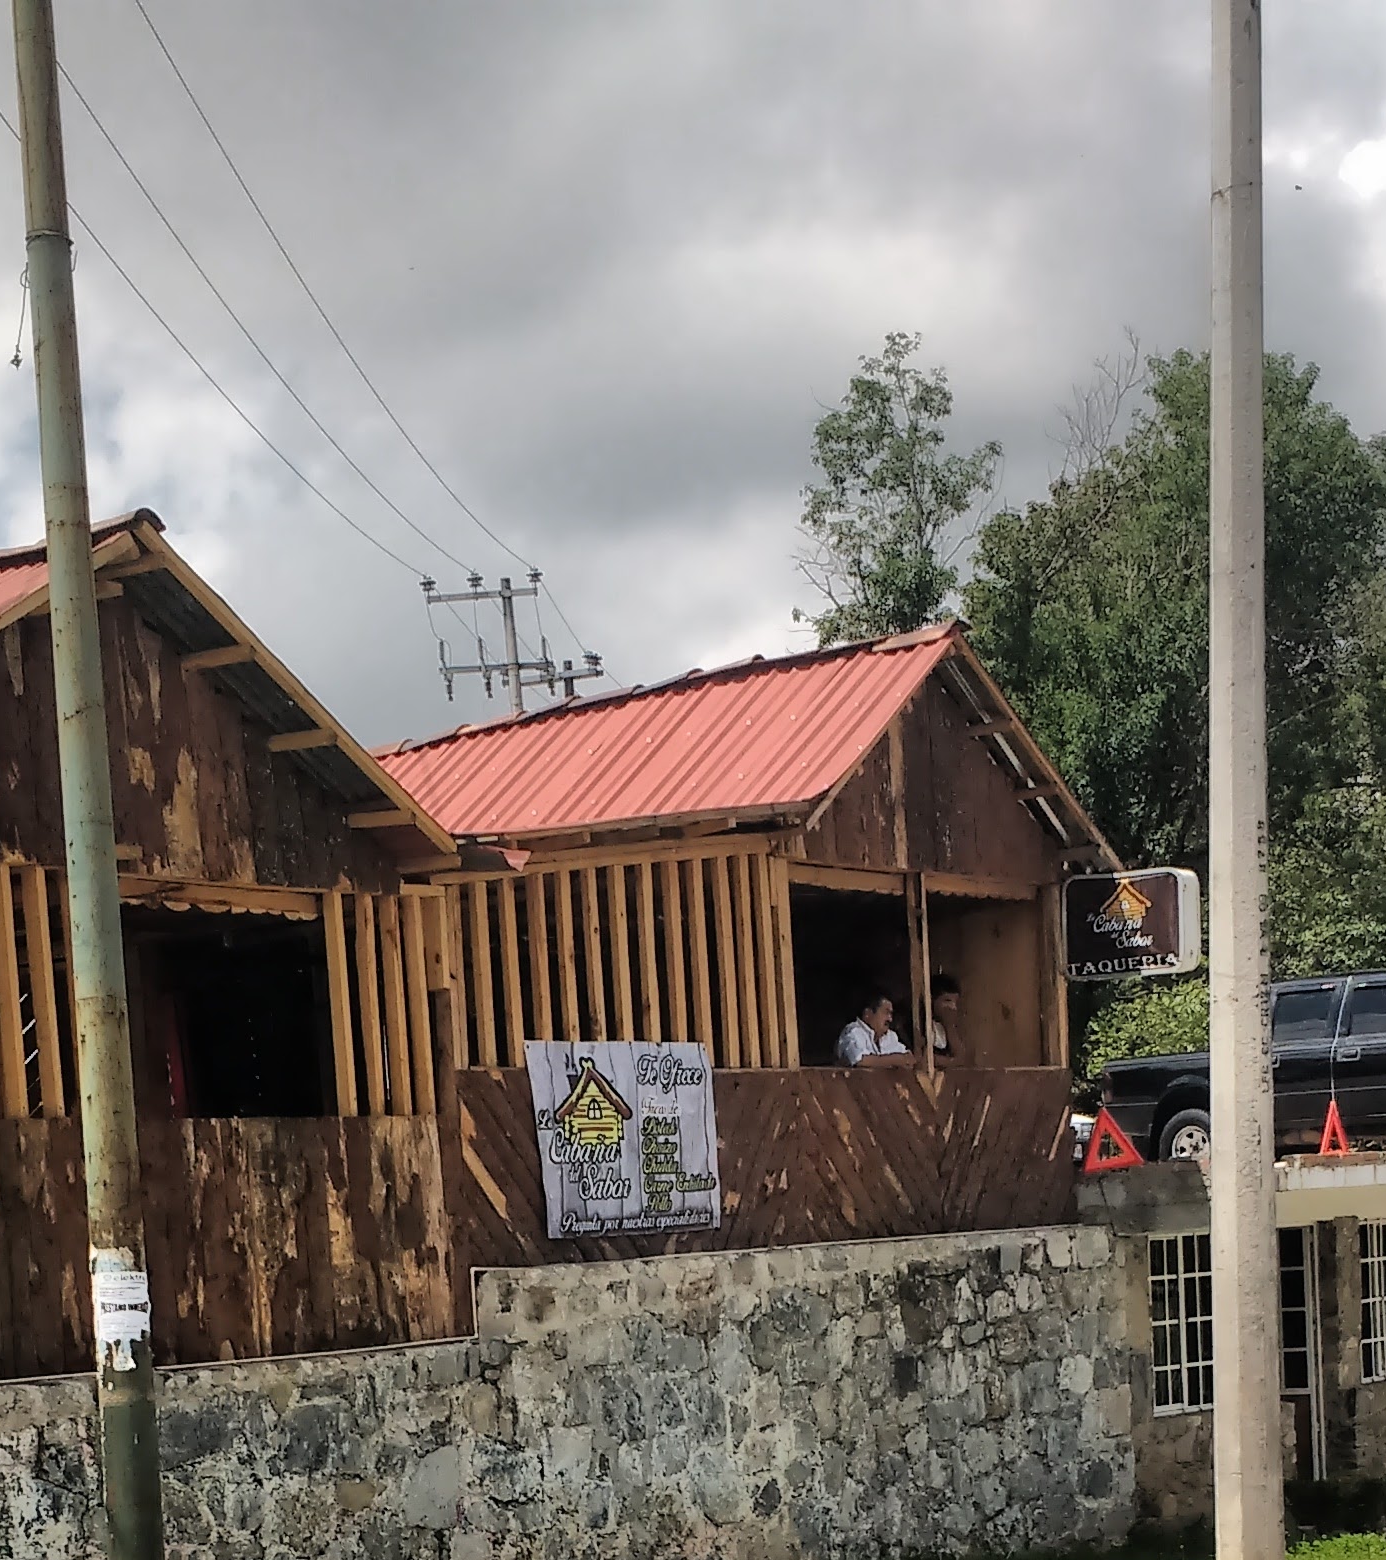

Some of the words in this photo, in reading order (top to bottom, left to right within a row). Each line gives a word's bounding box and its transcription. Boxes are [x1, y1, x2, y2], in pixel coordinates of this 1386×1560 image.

[1115, 930, 1154, 949] Sabor
[637, 1054, 658, 1086] Te
[659, 1054, 703, 1094] Ofrece
[578, 1163, 631, 1200] Sabor
